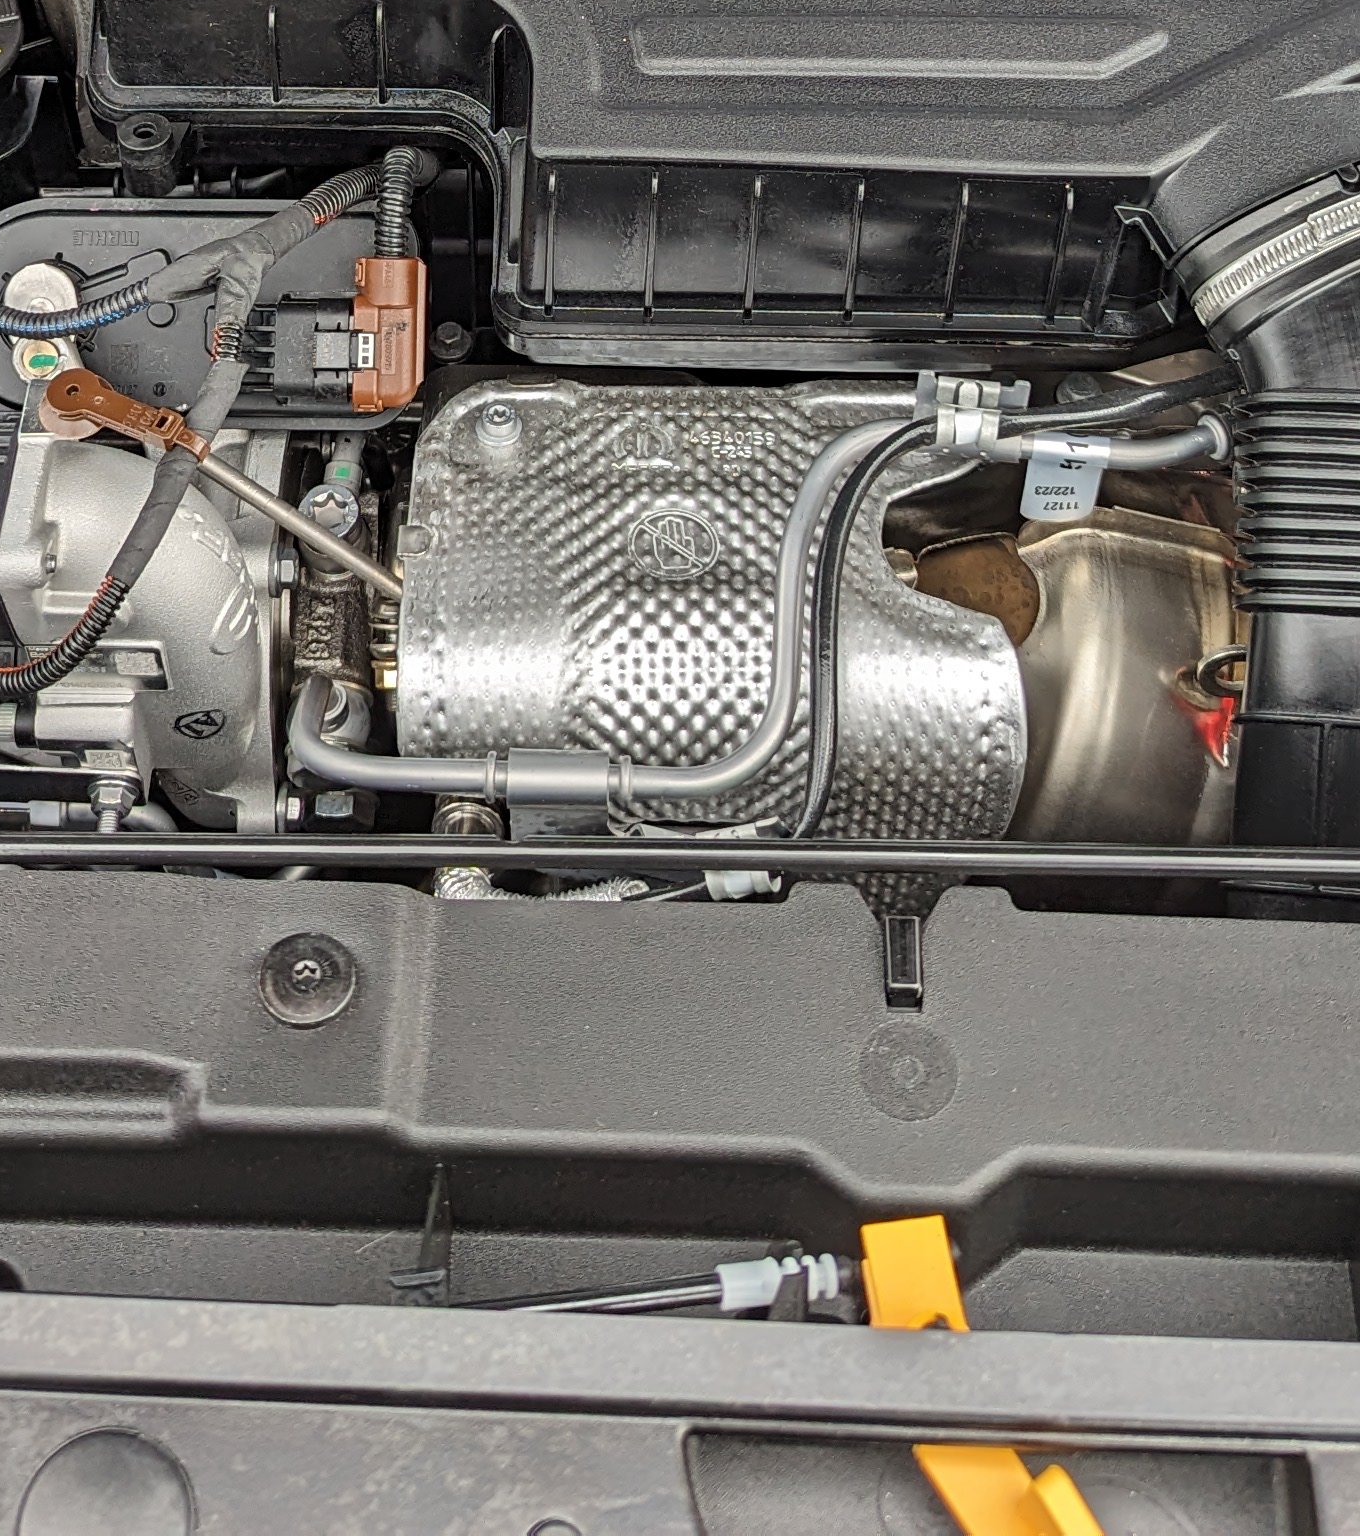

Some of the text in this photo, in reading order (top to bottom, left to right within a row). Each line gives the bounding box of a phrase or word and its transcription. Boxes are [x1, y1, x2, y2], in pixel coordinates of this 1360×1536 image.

[72, 230, 138, 247] MAHLE
[1033, 484, 1075, 496] 122/23
[1042, 500, 1079, 511] 11127
